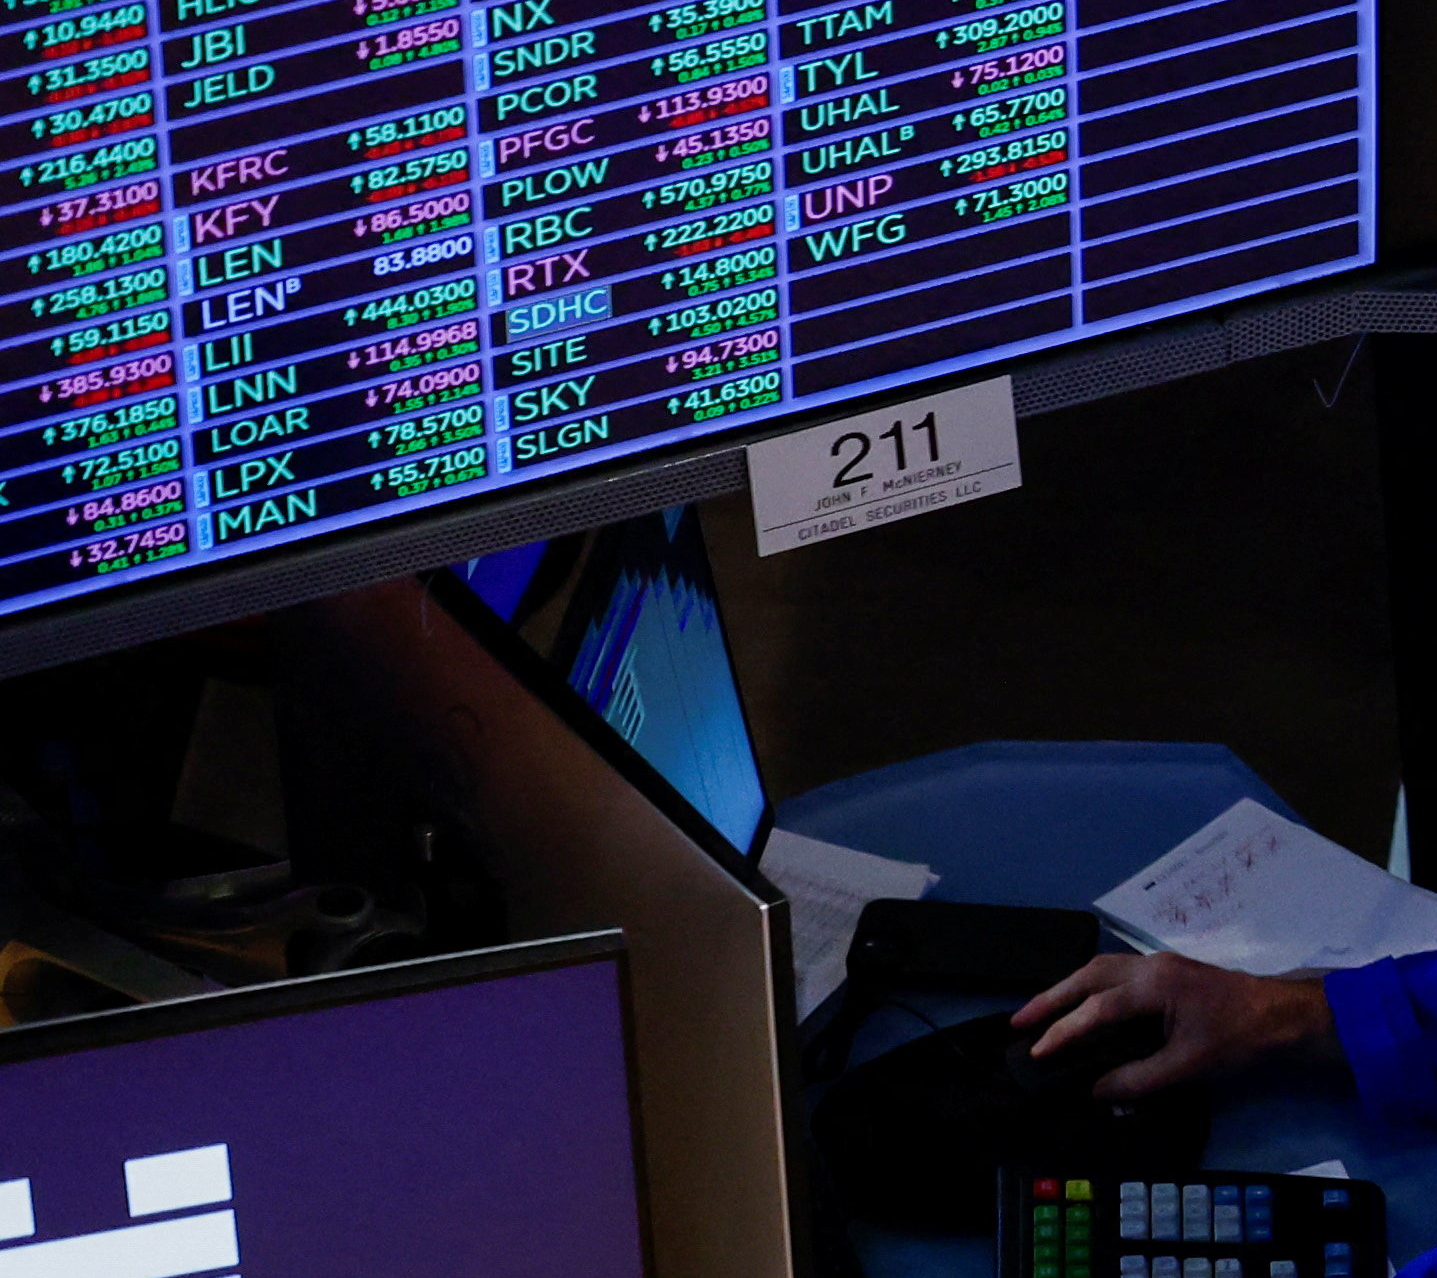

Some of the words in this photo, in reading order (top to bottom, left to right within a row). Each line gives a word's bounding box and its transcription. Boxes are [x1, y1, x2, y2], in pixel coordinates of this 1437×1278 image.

[195, 194, 280, 243] KFY
[368, 150, 468, 190] 82.5750
[212, 407, 310, 453] LOAR
[382, 364, 479, 405] 74.0900
[831, 411, 939, 488] 211
[798, 516, 857, 541] CITADEL
[865, 490, 948, 523] SECURITIES
[955, 481, 982, 498] LLC
[814, 491, 851, 512] JOHN
